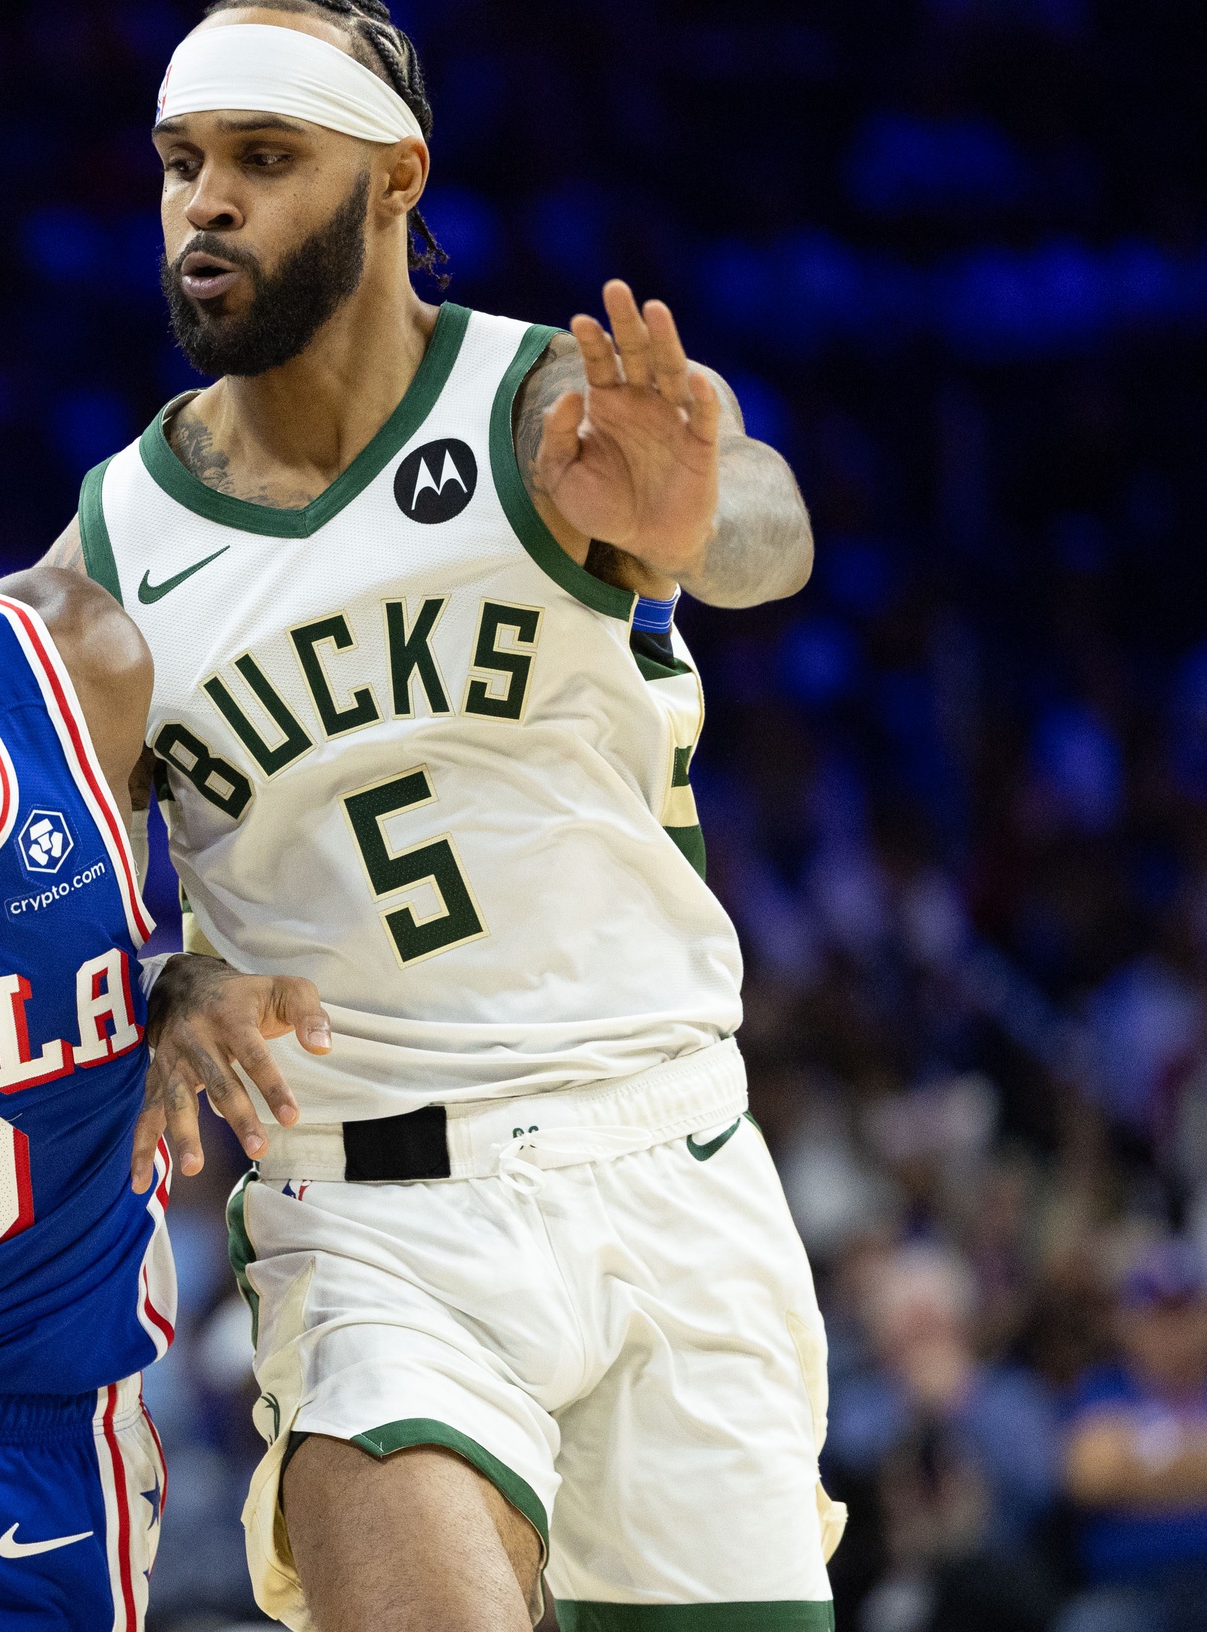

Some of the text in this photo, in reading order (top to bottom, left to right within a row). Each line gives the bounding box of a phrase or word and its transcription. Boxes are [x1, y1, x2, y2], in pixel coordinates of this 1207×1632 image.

[152, 596, 544, 822] BUCKS
[10, 862, 105, 915] crypto.com
[339, 765, 489, 968] 5
